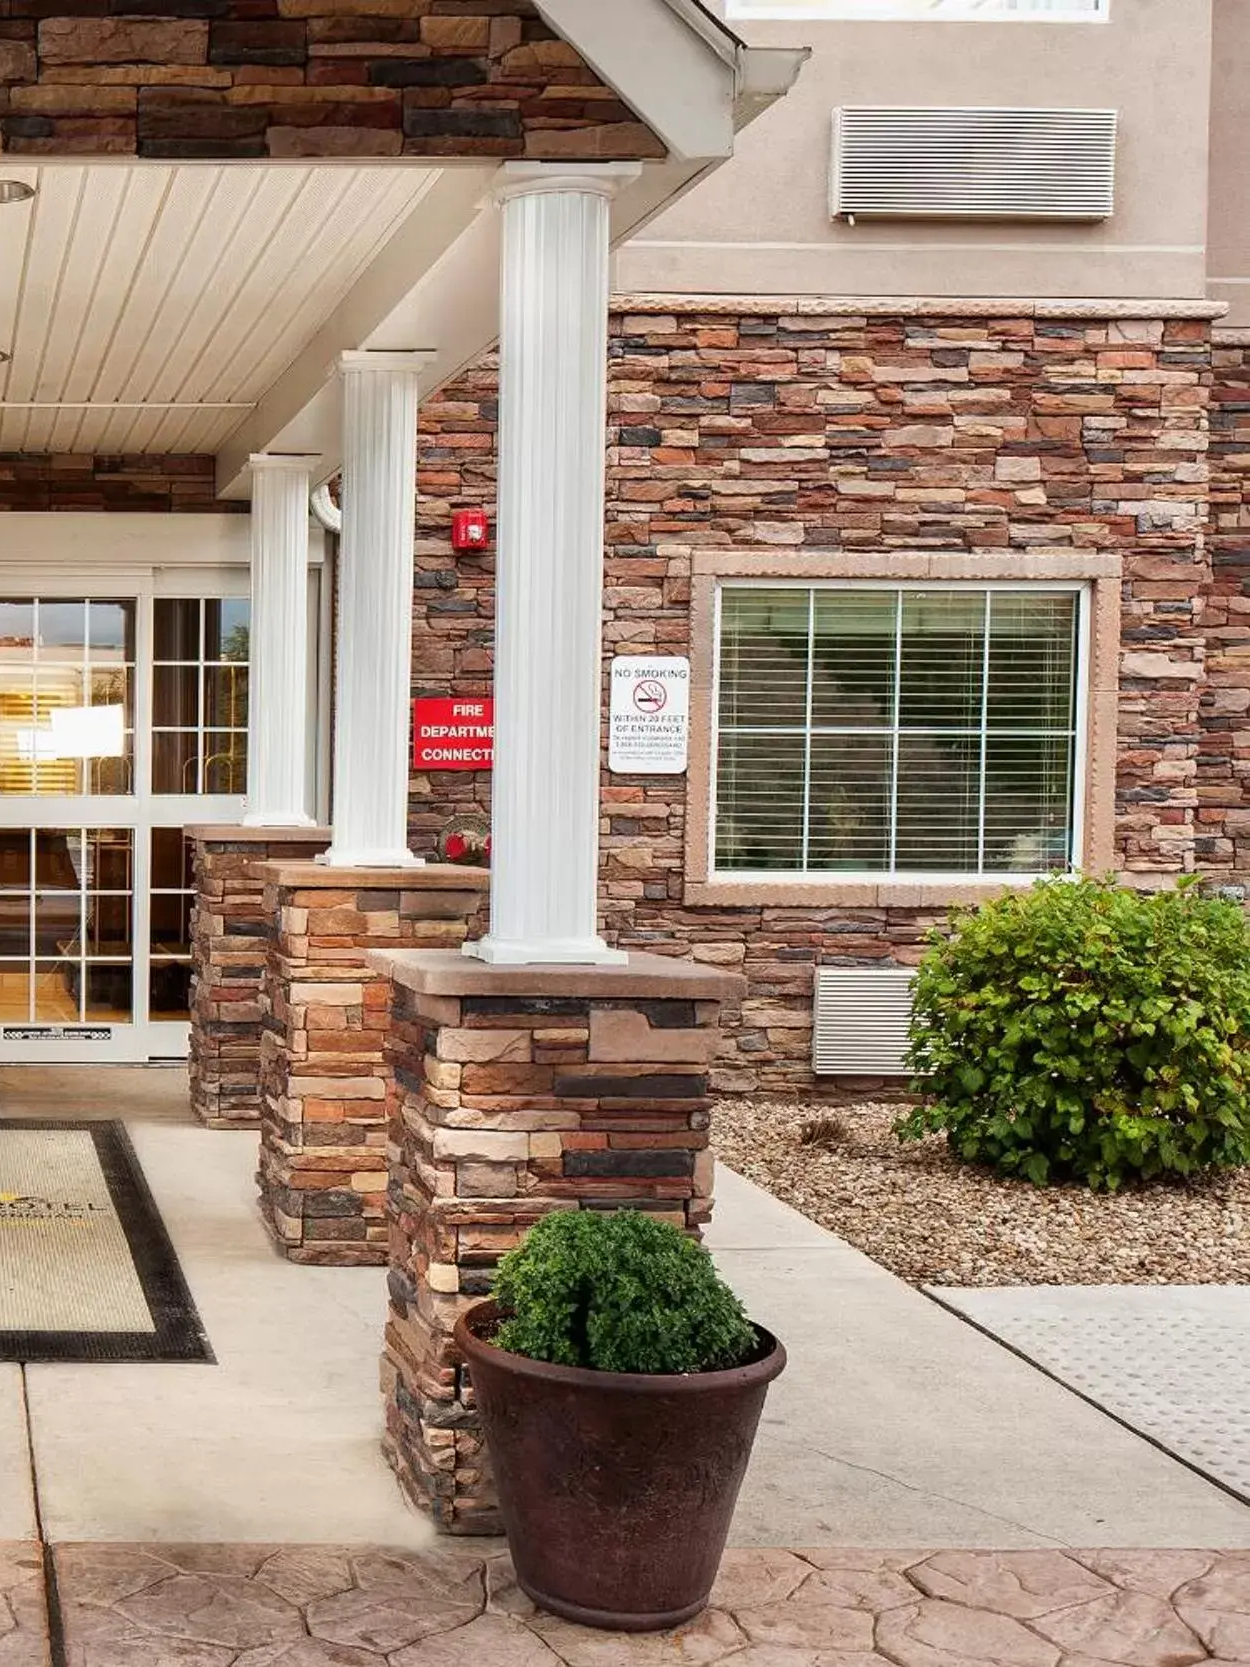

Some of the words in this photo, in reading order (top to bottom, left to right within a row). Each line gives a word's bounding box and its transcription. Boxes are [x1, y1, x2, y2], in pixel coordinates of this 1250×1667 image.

[614, 669, 631, 678] NO
[634, 669, 688, 679] SMOKING
[453, 704, 485, 717] FIRE
[661, 714, 686, 722] FEET
[421, 725, 495, 738] DEPARTME
[616, 725, 630, 733] OF
[631, 724, 683, 734] ENTRANCE
[421, 748, 495, 761] CONNECTI
